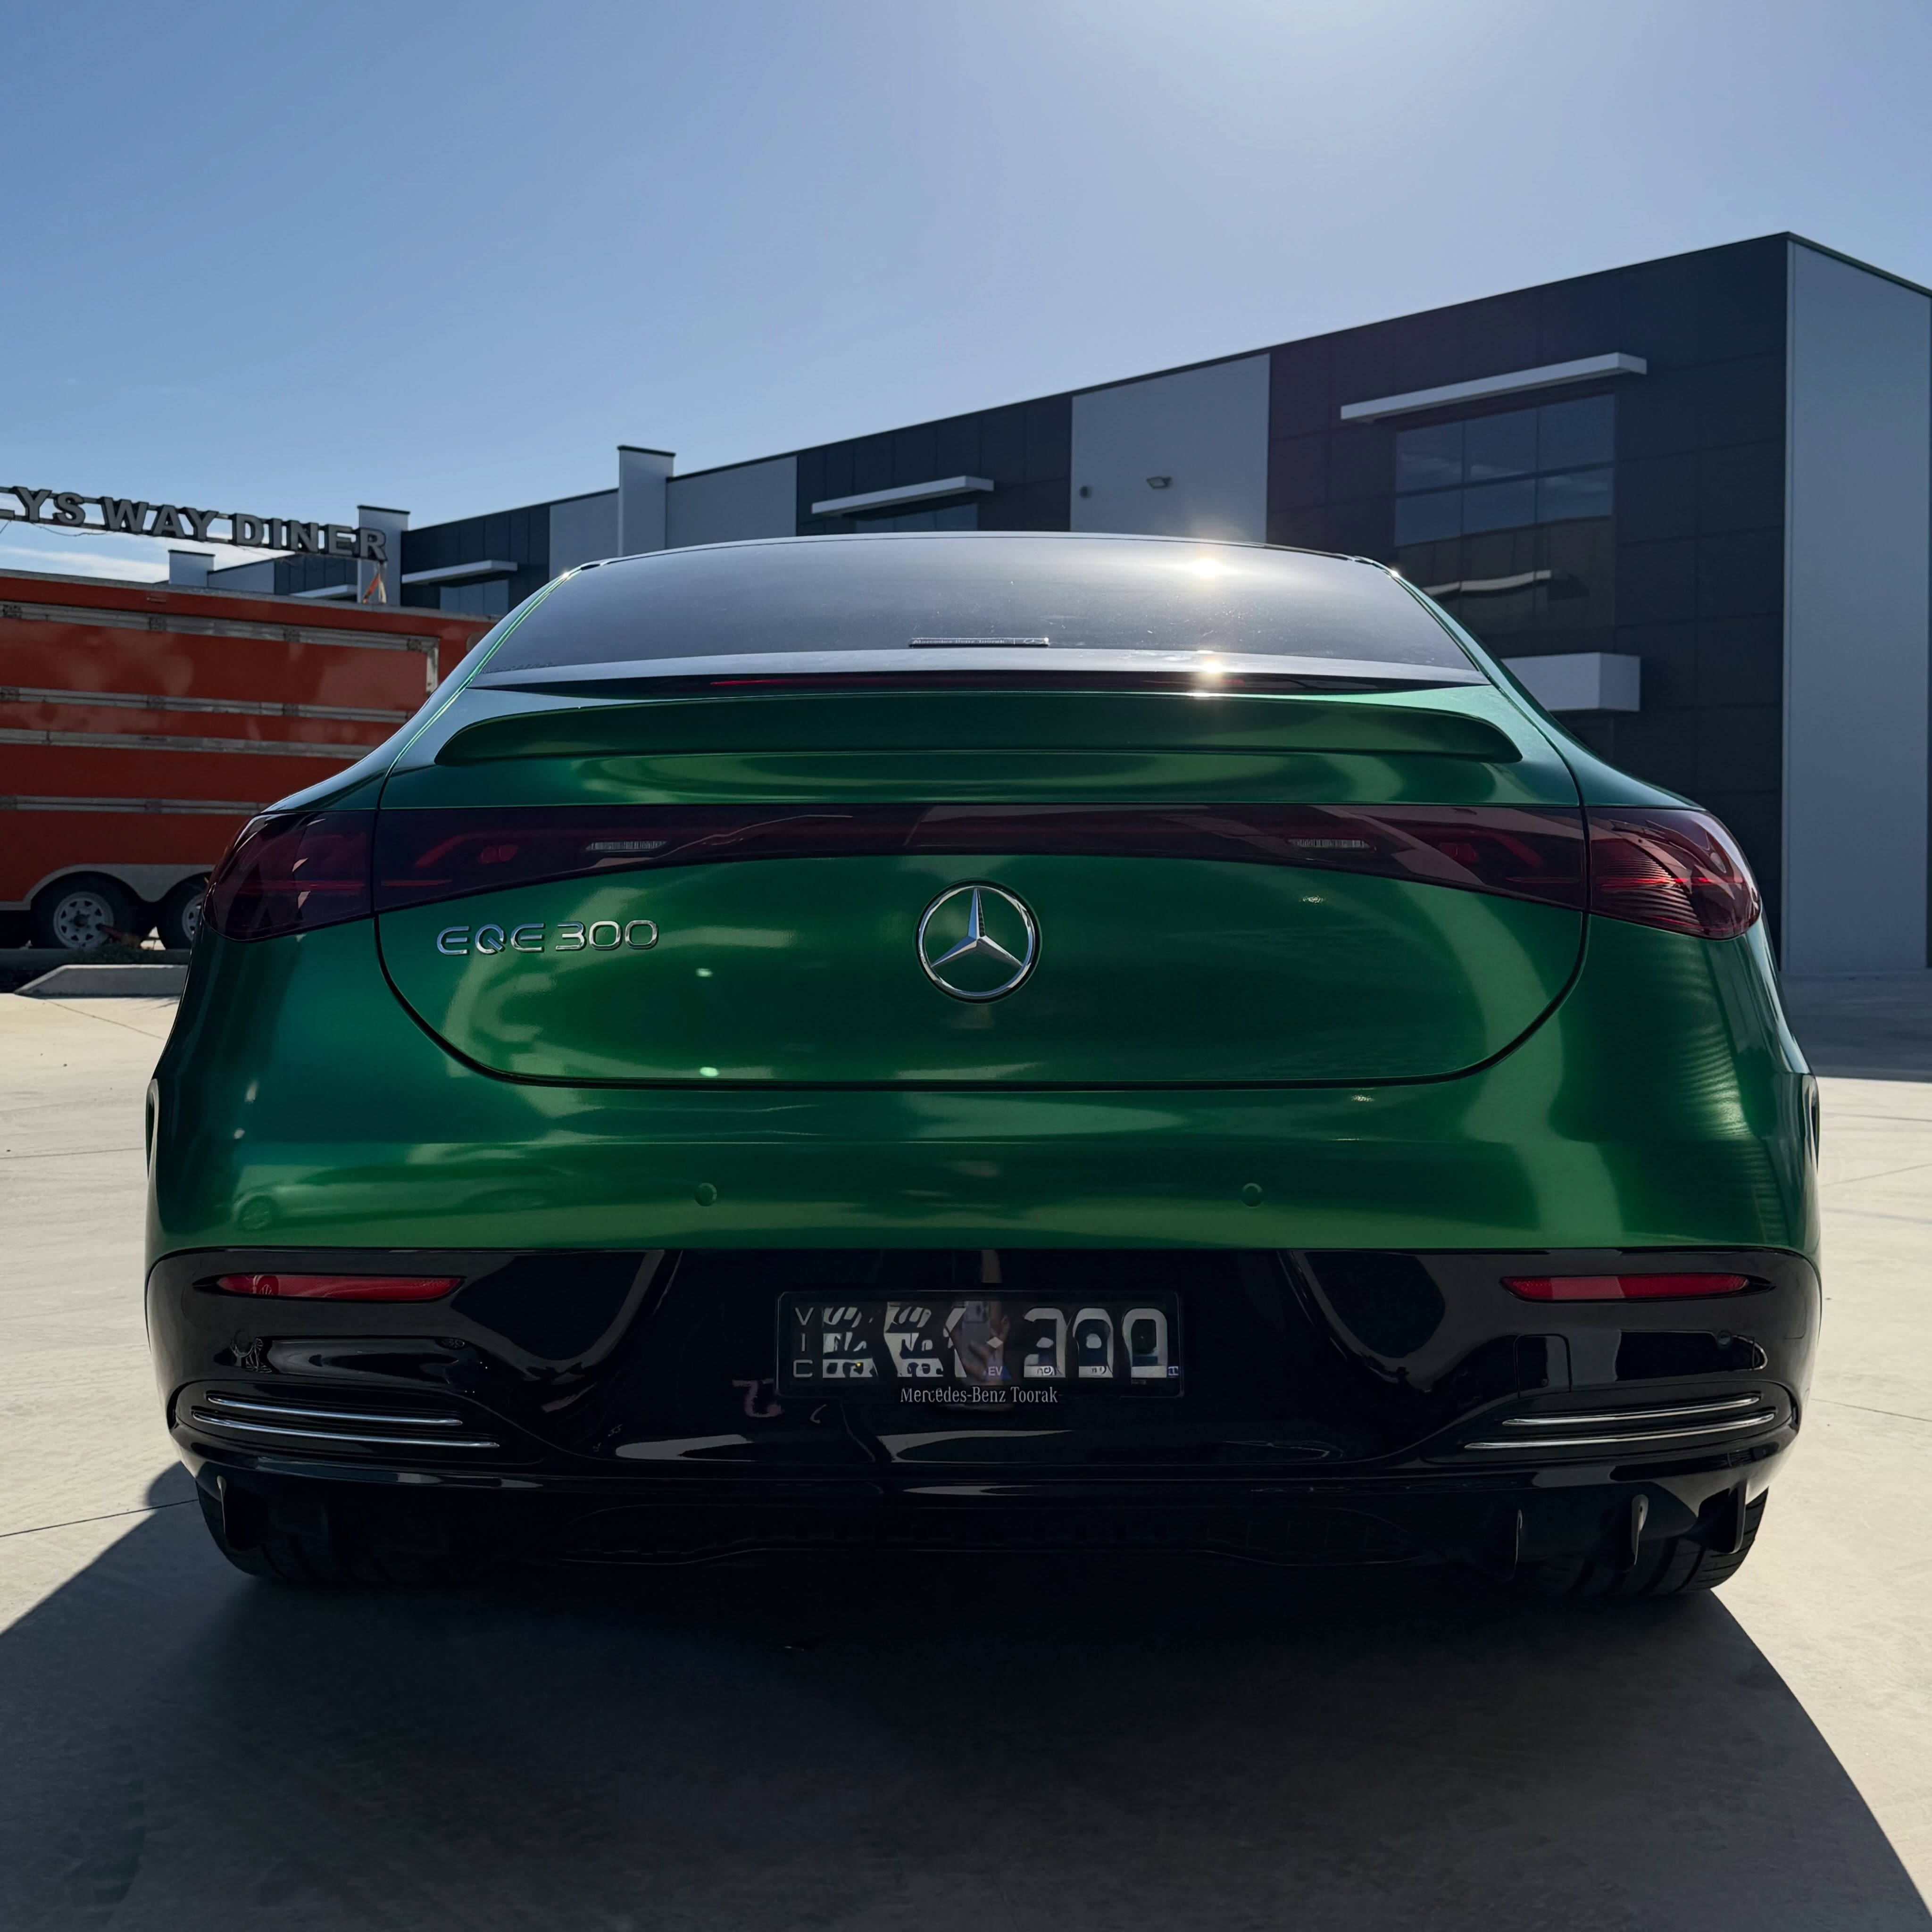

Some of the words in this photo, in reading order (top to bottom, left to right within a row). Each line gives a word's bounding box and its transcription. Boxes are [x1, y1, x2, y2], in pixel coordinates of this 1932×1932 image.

[98, 496, 220, 541] WAY
[231, 513, 388, 561] DINER
[436, 923, 545, 955] EQE
[555, 919, 659, 951] 300
[988, 1366, 1004, 1376] EV
[900, 1385, 1006, 1404] Mercedes-Benz
[1010, 1386, 1059, 1404] Toorak
